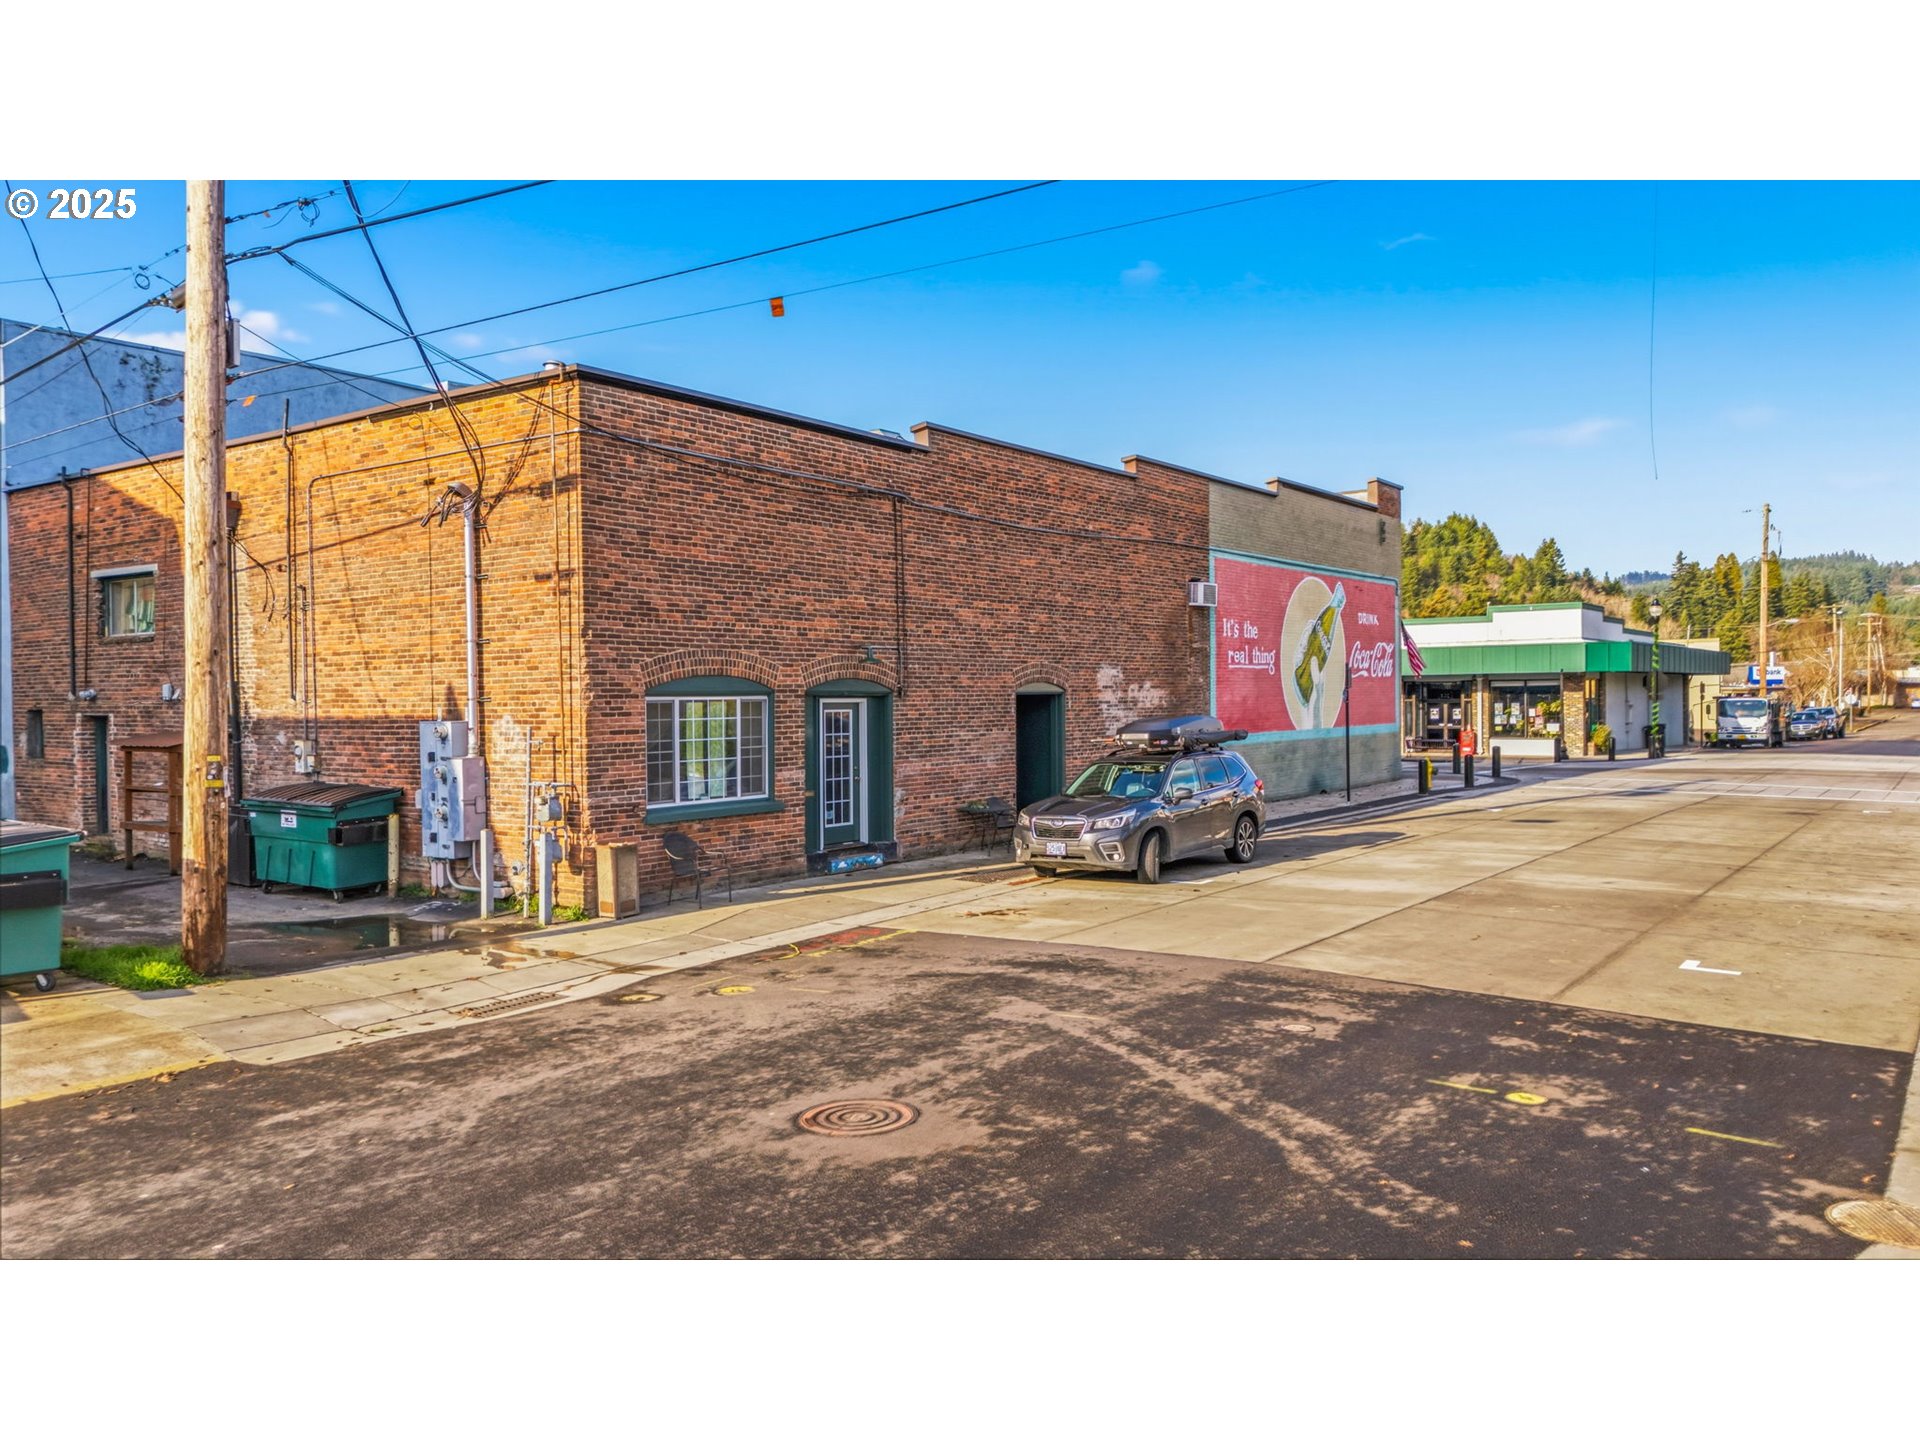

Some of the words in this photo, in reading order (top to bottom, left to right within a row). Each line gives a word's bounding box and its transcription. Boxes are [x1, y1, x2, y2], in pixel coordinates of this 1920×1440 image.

[1223, 618, 1240, 638] It's
[1243, 620, 1258, 639] the
[1358, 612, 1379, 626] DRINK
[1228, 645, 1249, 665] real
[1252, 646, 1276, 675] thing
[1349, 641, 1394, 678] Coca-Cola
